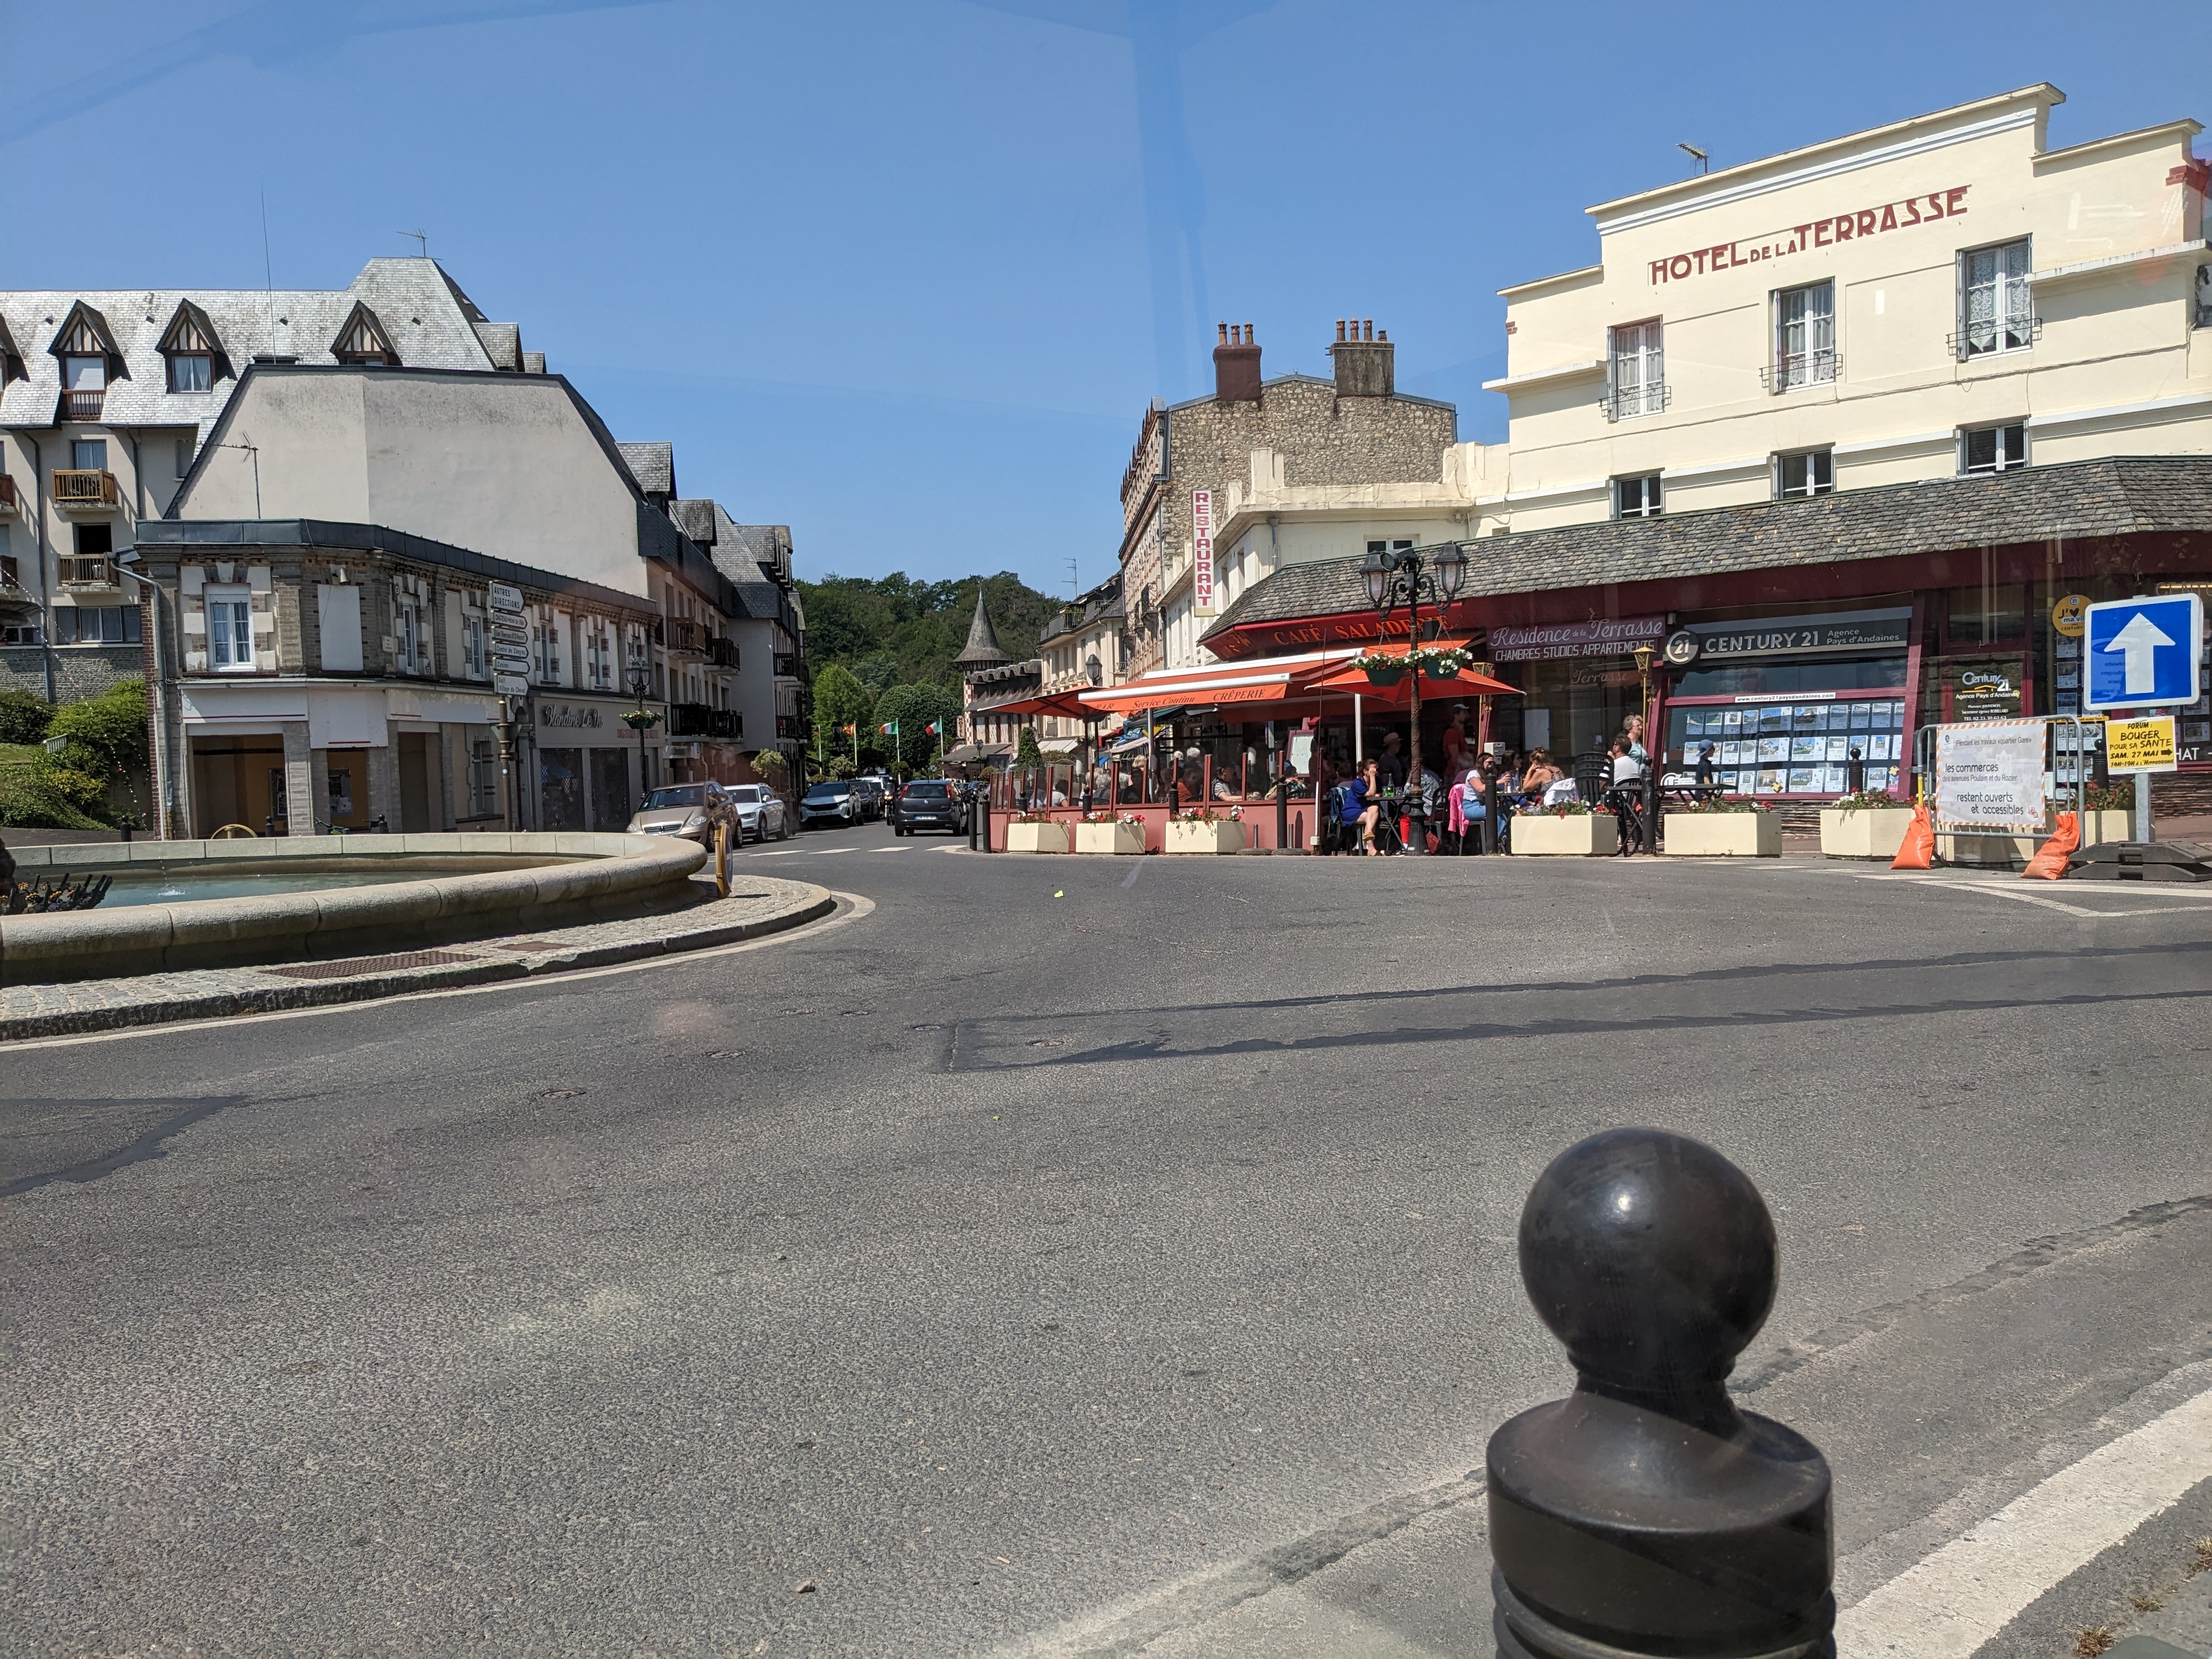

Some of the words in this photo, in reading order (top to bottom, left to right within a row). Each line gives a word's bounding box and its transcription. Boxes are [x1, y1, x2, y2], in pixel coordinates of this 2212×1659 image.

[1652, 242, 1748, 286] HOTEL
[1750, 245, 1772, 263] DE
[1775, 239, 1797, 258] LA
[1794, 185, 1968, 252] TERRASSE
[1195, 493, 1212, 606] RESTAURANT
[494, 586, 511, 597] AUTRES
[494, 596, 520, 609] DIRECTIONS
[1274, 623, 1325, 646] CAFÉ
[1490, 625, 1571, 647] Residence
[1587, 619, 1663, 639] Terrasse
[1827, 629, 1860, 638] Agence
[1705, 632, 1797, 653] CENTURY
[1801, 631, 1819, 647] 21
[1826, 637, 1847, 646] Pays
[1849, 634, 1899, 643] d'Andaines
[1495, 648, 1540, 662] CHAMBRES
[1543, 645, 1579, 658] STUDIOS
[1582, 640, 1655, 656] APPARTEMENTS
[1962, 672, 2001, 685] Century
[1997, 679, 2009, 692] 21
[1133, 699, 1161, 709] Service
[1163, 696, 1195, 705] Continu
[1213, 689, 1266, 701] CRÊPERIE
[1736, 693, 1835, 702] www.century21paysdandaines.com
[545, 704, 580, 727] Blandine
[2127, 721, 2149, 730] FORUM
[2120, 730, 2160, 741] BOUGER
[1956, 738, 1973, 747] Pendant
[2140, 738, 2172, 749] SANTE
[1945, 763, 1955, 773] les
[1956, 763, 1999, 773] commerces
[1970, 774, 1988, 782] Poulain
[1956, 791, 1983, 803] restent
[1984, 791, 2013, 803] ouverts
[1971, 804, 1979, 814] et
[1982, 804, 2024, 815] accessibles
